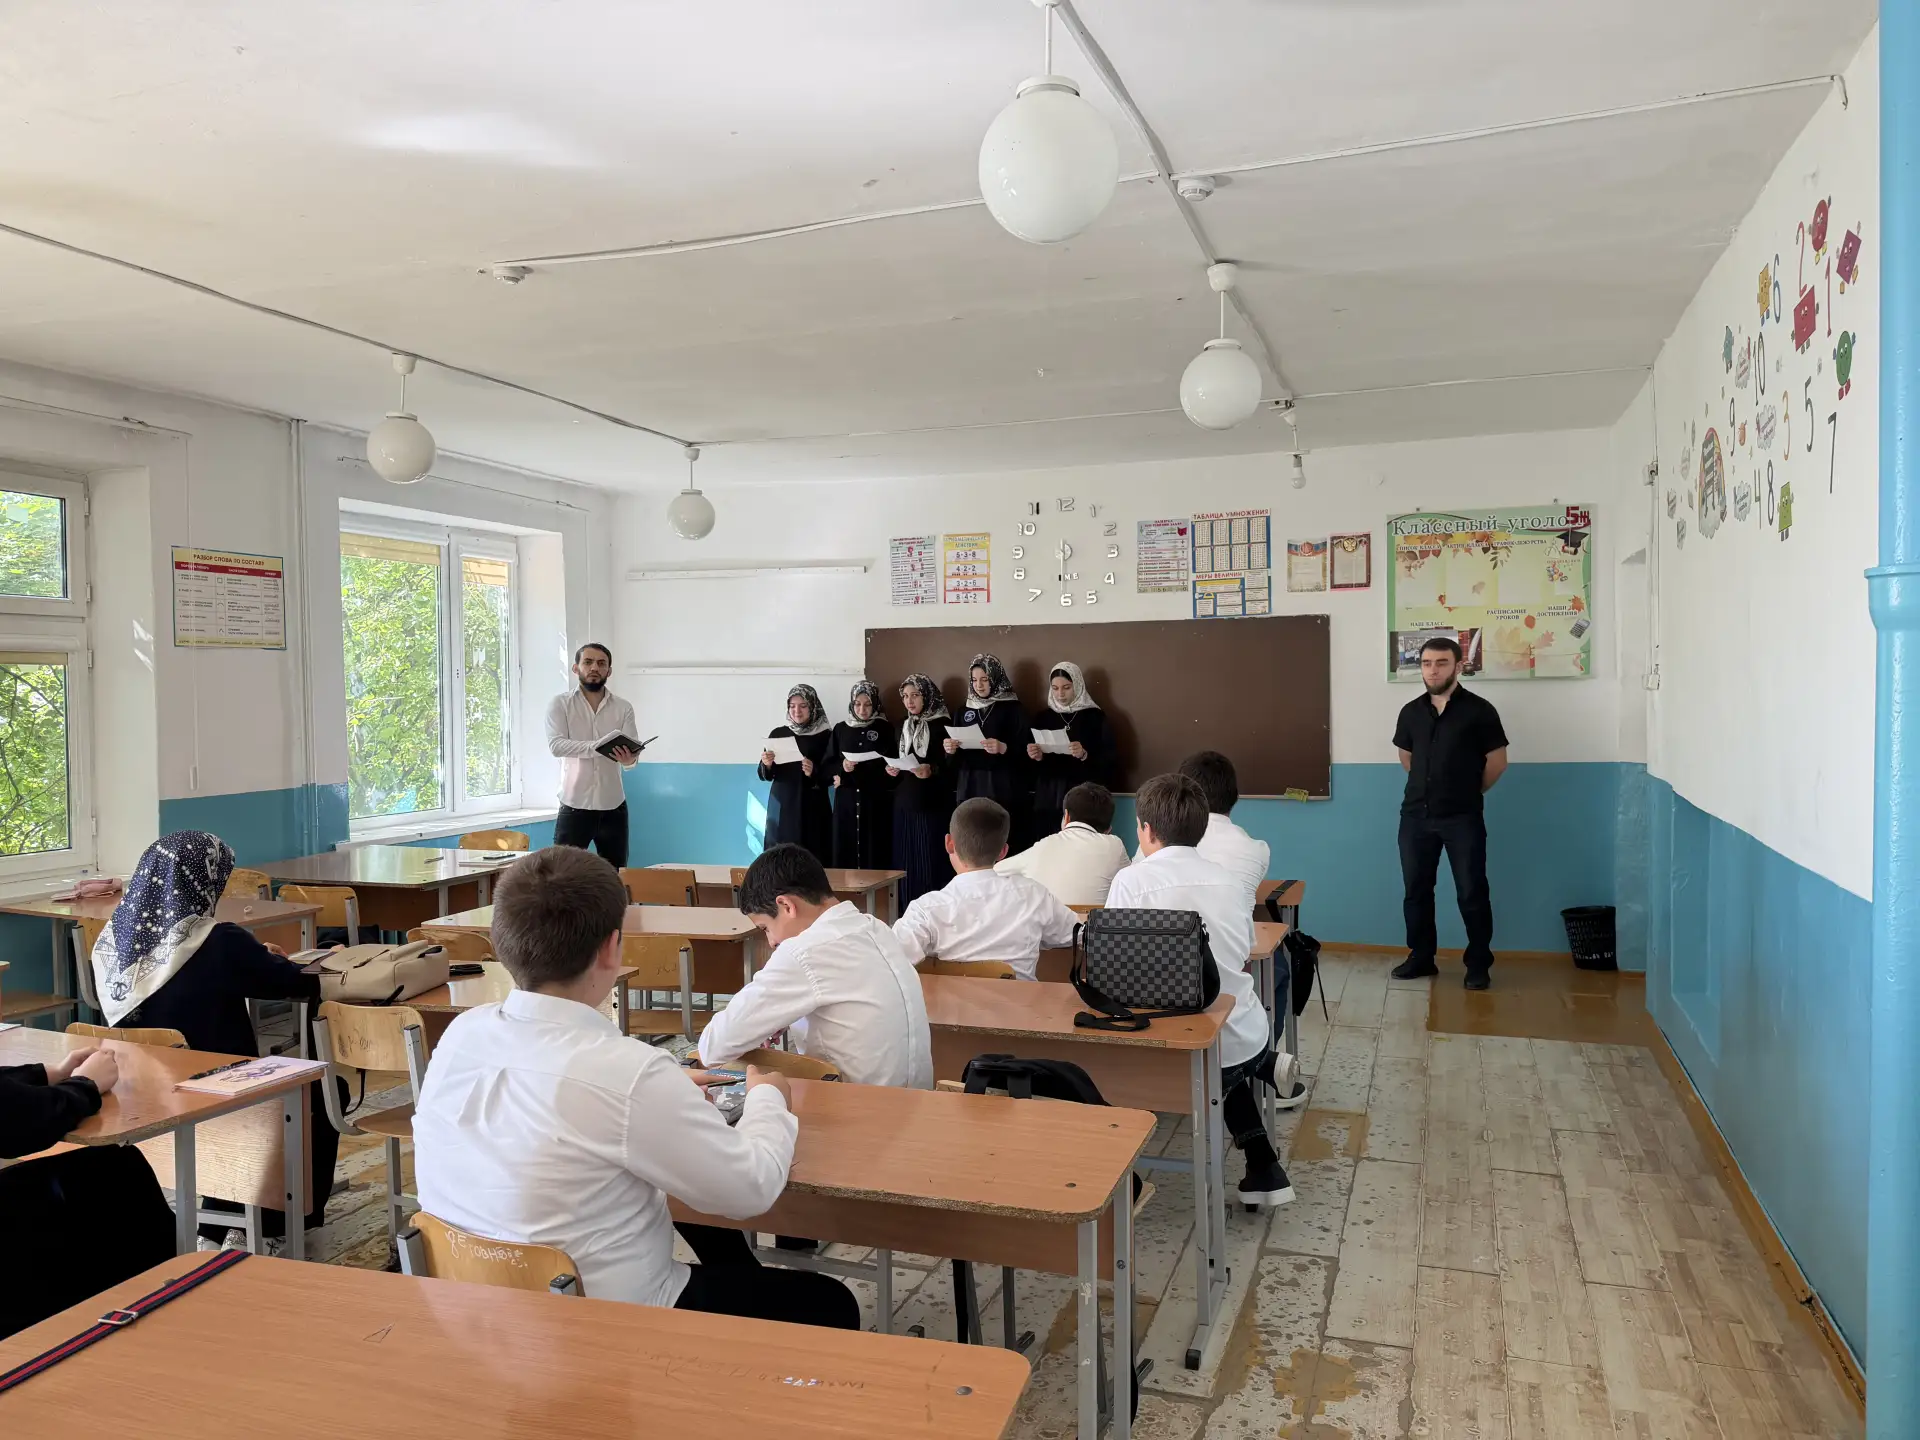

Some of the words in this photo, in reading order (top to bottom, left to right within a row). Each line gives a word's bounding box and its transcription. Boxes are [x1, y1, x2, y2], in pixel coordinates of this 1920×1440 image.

[1796, 221, 1808, 298] 2
[1773, 253, 1781, 324] 6
[1753, 332, 1766, 406] 10
[1805, 376, 1814, 452] 5
[1729, 397, 1736, 456] 9
[1782, 390, 1790, 460] 3
[1828, 411, 1837, 494] 7
[1754, 468, 1761, 530] 4
[1767, 459, 1775, 526] 8
[1056, 497, 1075, 511] 12
[1193, 512, 1223, 520] ТАБЛИЦА
[1225, 508, 1269, 517] УМНОЖЕНИЯ
[1018, 522, 1036, 536] 10
[1103, 523, 1116, 536] 2
[1393, 516, 1498, 536] Классный
[1012, 546, 1024, 559] 9
[1107, 544, 1119, 558] 3
[1014, 567, 1025, 580] 8
[1104, 572, 1115, 585] 4
[1028, 588, 1042, 602] 7
[1060, 593, 1072, 607] 6
[1086, 590, 1098, 604] 5
